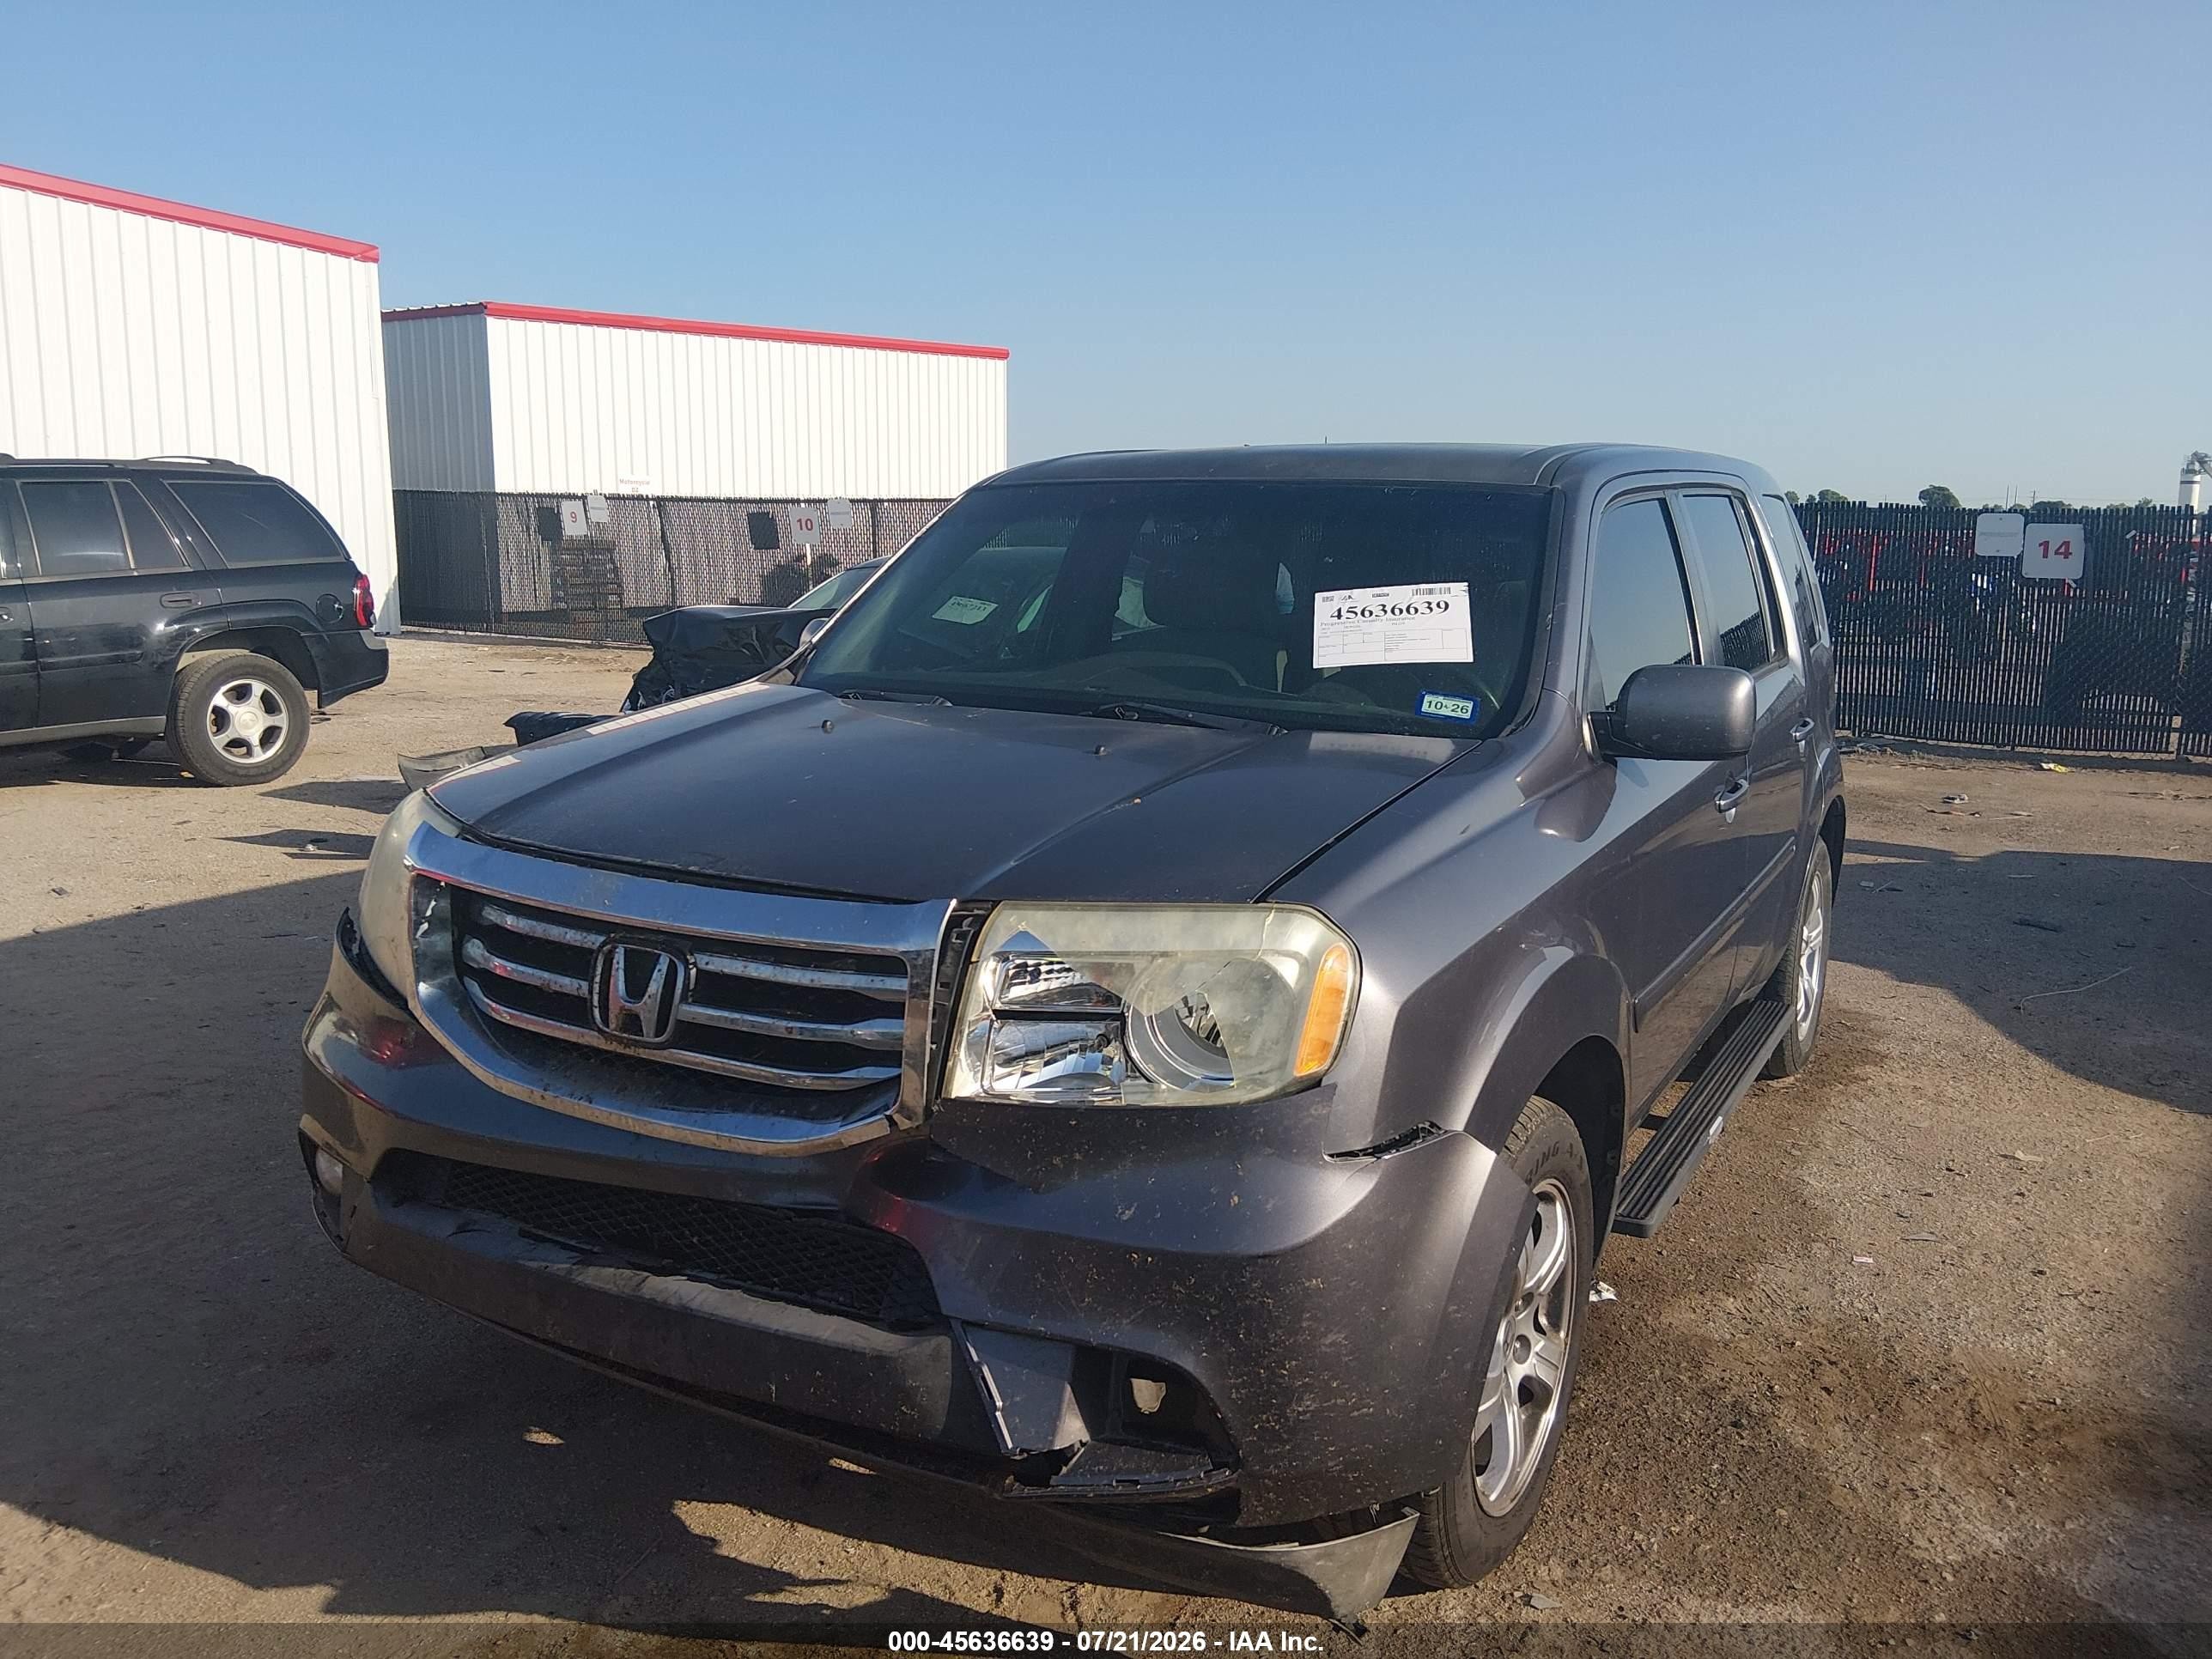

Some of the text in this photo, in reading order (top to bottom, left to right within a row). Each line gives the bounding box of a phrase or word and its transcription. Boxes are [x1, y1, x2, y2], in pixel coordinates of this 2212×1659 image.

[569, 511, 578, 523] 9
[796, 518, 814, 531] 10
[2038, 540, 2073, 559] 14
[1330, 599, 1449, 621] 45636639
[1426, 700, 1470, 714] 10 26
